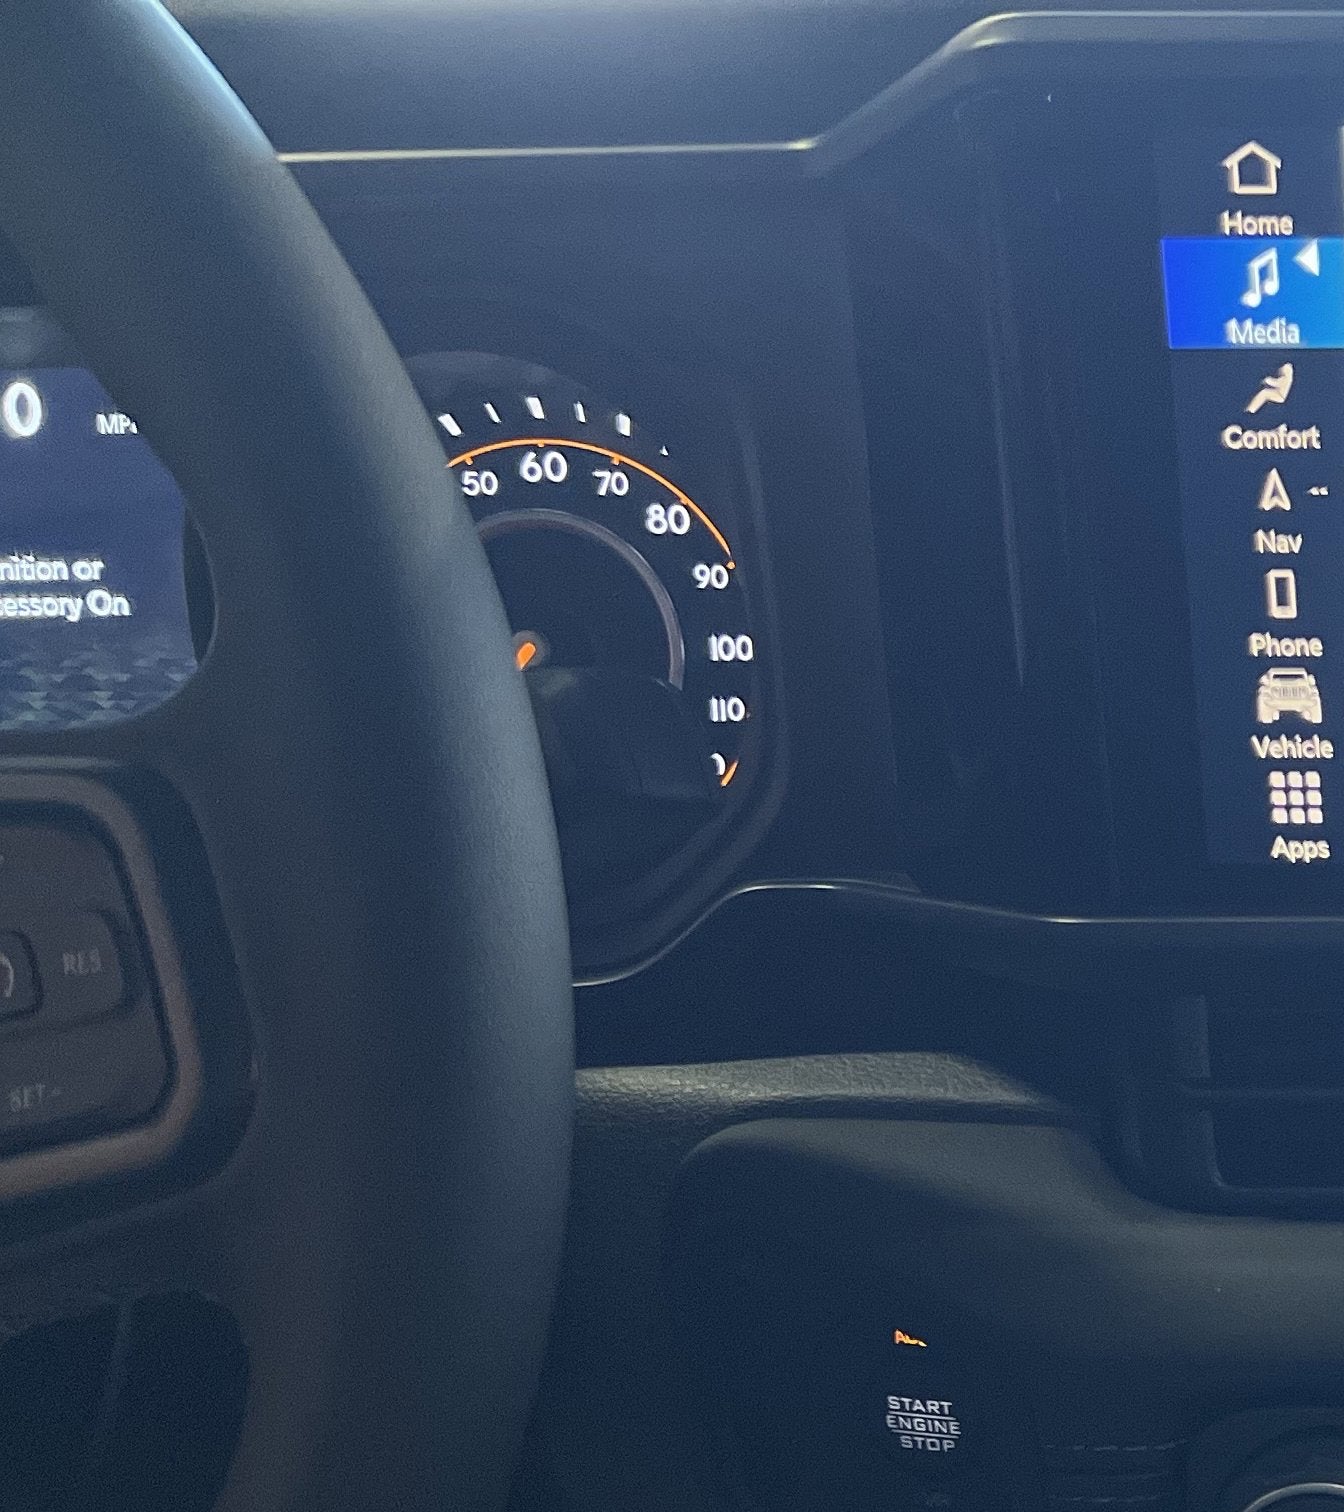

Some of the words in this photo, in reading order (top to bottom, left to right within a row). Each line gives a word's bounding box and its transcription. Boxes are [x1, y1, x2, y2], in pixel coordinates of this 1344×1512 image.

[1221, 211, 1294, 237] Home
[1226, 319, 1300, 345] Media
[96, 412, 138, 436] MP
[1222, 424, 1321, 450] Comfort
[519, 451, 568, 483] 60
[461, 470, 499, 497] 50
[591, 470, 630, 497] 70
[645, 503, 691, 535] 80
[1254, 530, 1302, 554] Nav
[72, 558, 104, 581] or
[692, 563, 730, 589] 90
[86, 588, 132, 616] On
[708, 633, 754, 662] 100
[1248, 633, 1324, 657] Phone
[709, 696, 746, 723] 110
[1251, 735, 1334, 760] Vehicle
[1270, 837, 1331, 863] Apps
[887, 1395, 952, 1415] START
[885, 1415, 961, 1435] ENGINE
[899, 1435, 955, 1452] STOP
